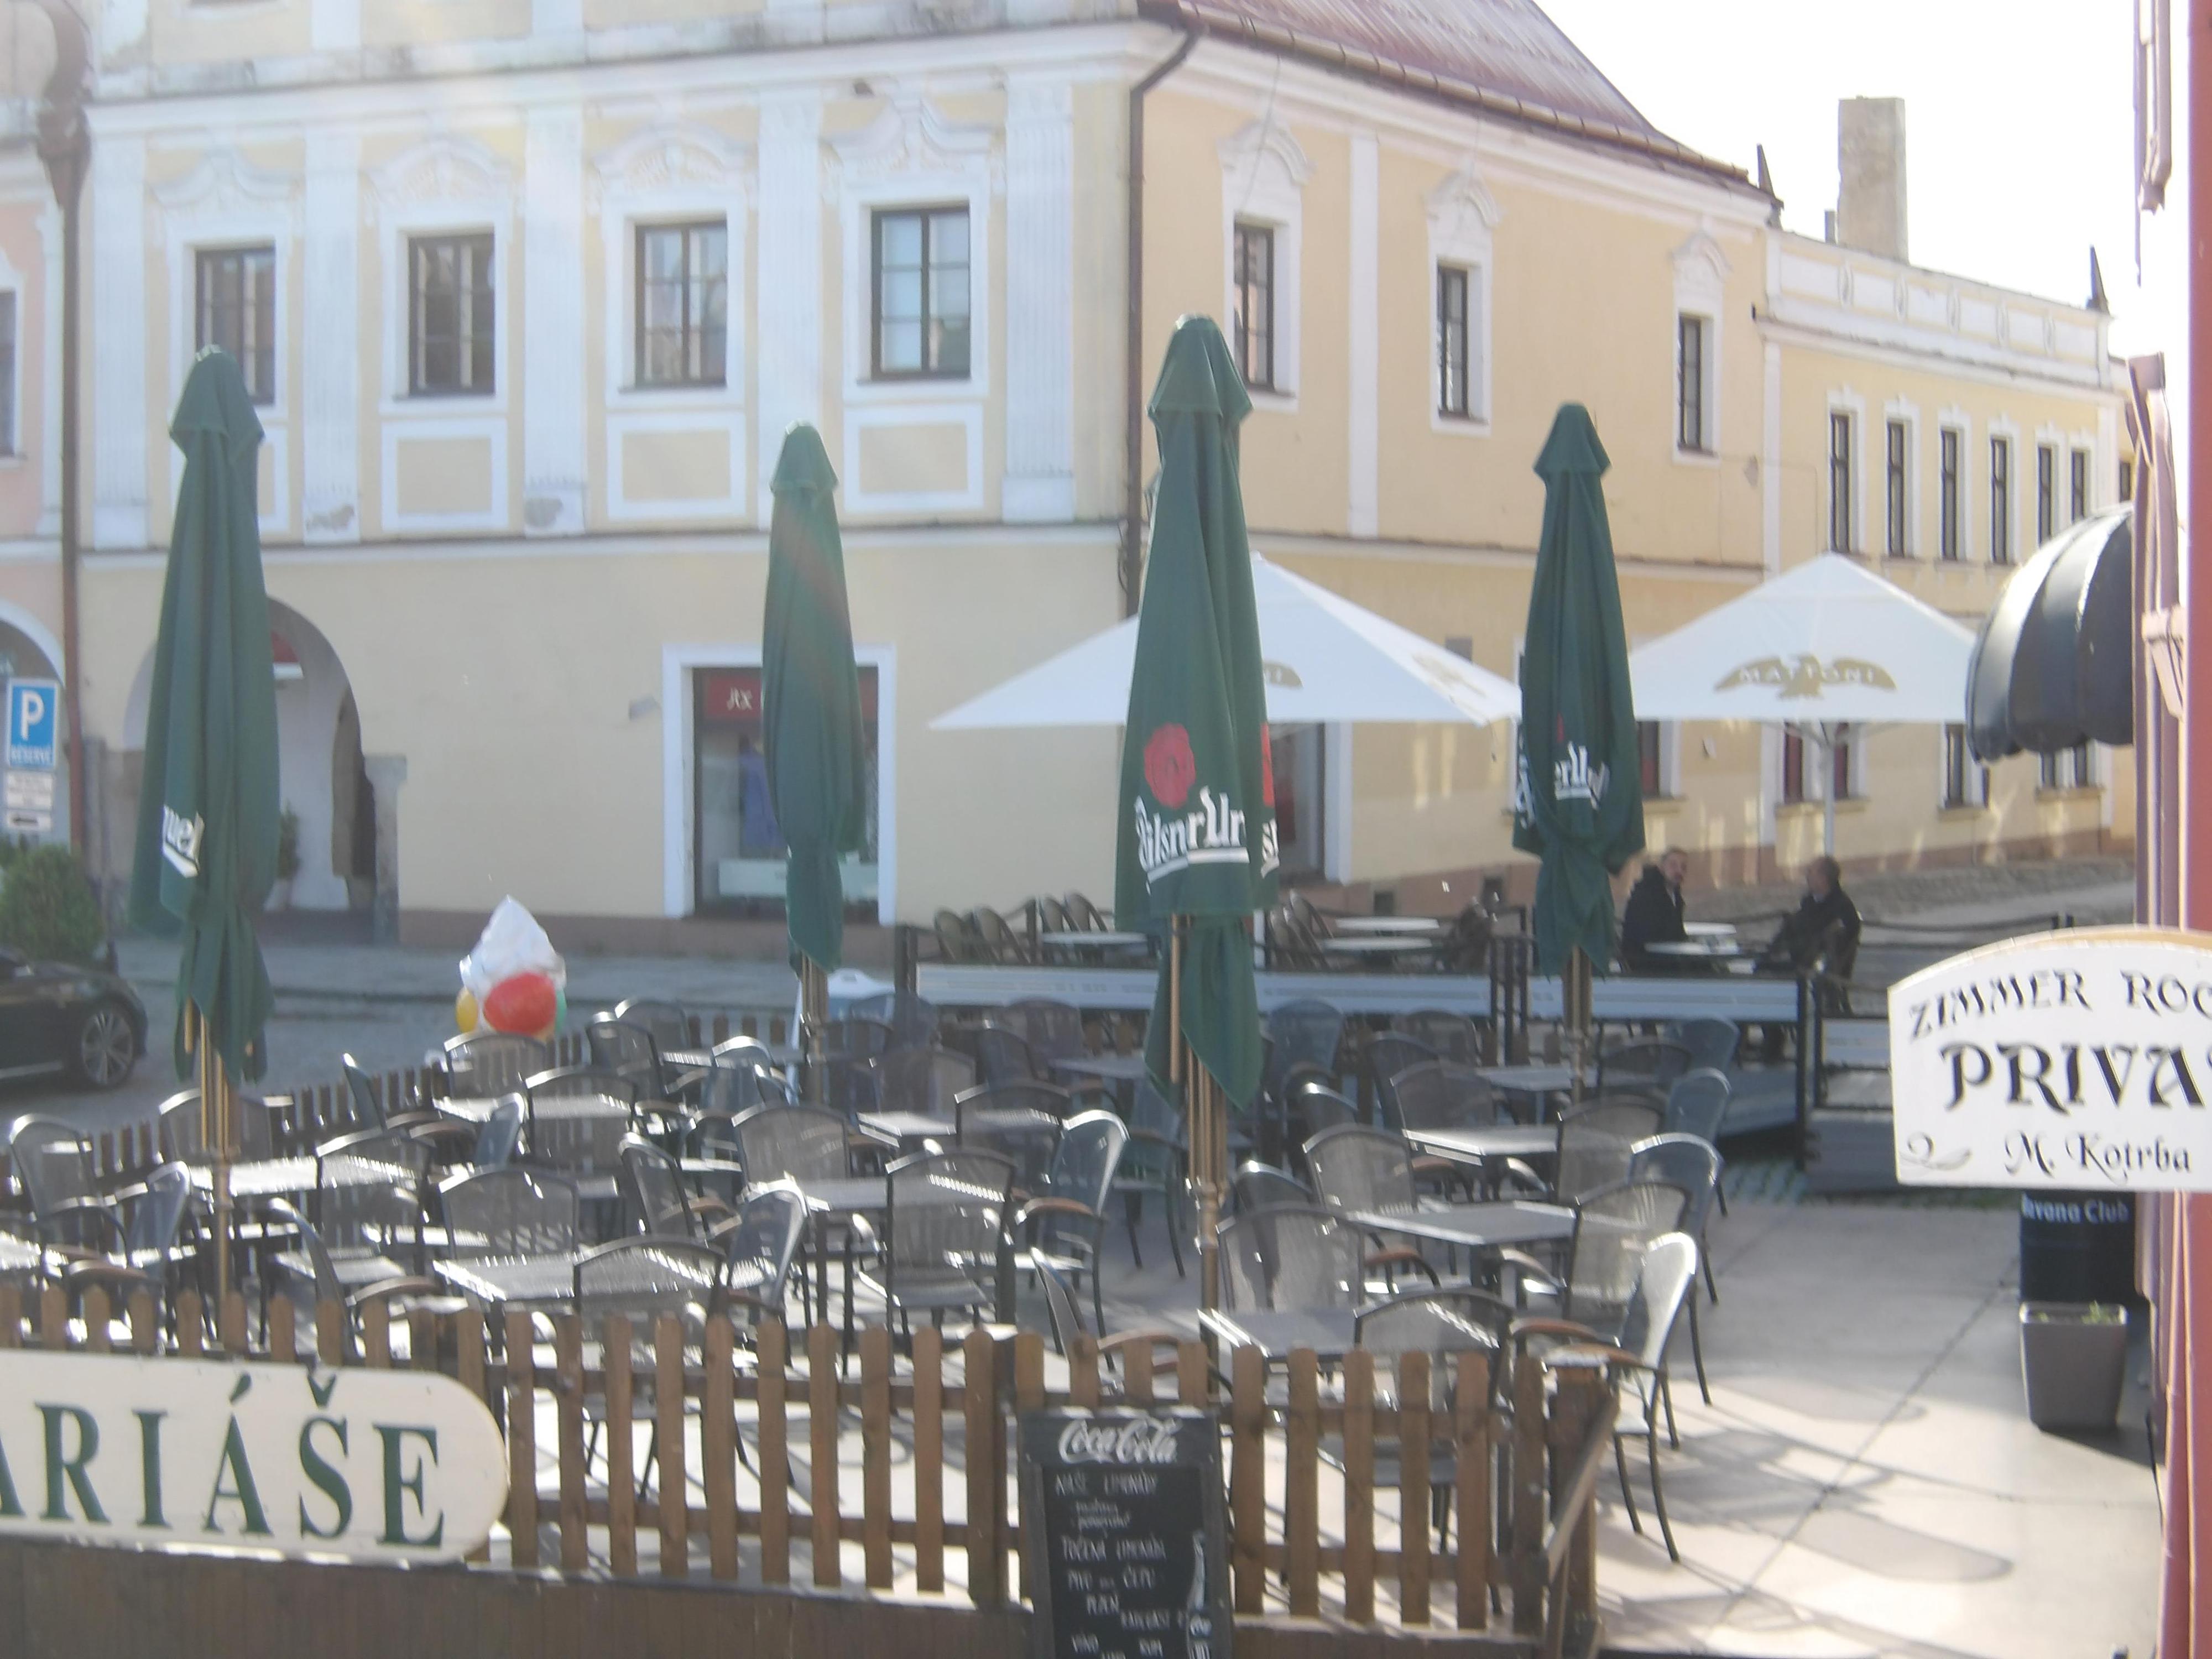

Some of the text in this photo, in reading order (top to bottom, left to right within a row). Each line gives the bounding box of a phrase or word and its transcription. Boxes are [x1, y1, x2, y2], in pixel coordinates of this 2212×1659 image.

[1740, 664, 1875, 685] MATTONI
[20, 690, 45, 741] P
[1909, 968, 2093, 1041] ZIMMER
[1939, 1040, 2212, 1116] PRIVA
[2064, 1131, 2192, 1187] Kotrba
[2084, 1196, 2130, 1225] Club
